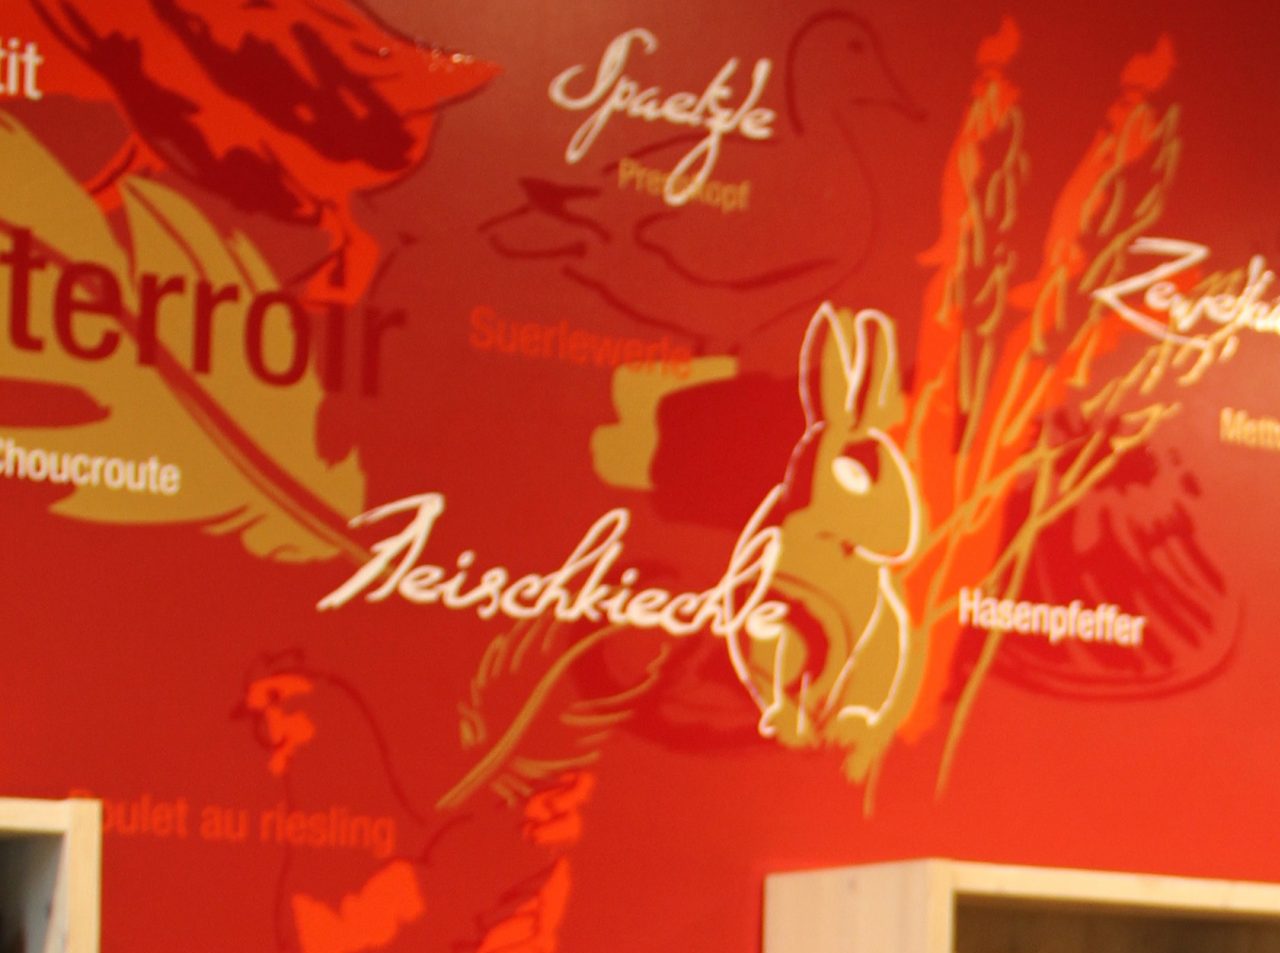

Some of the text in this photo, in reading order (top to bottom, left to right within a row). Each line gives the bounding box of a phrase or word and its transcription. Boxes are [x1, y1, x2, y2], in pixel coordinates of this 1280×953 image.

[0, 37, 43, 101] it
[0, 227, 406, 398] terroir
[959, 587, 1146, 646] Hasenpfeffer
[68, 788, 396, 858] oulet au riesling
